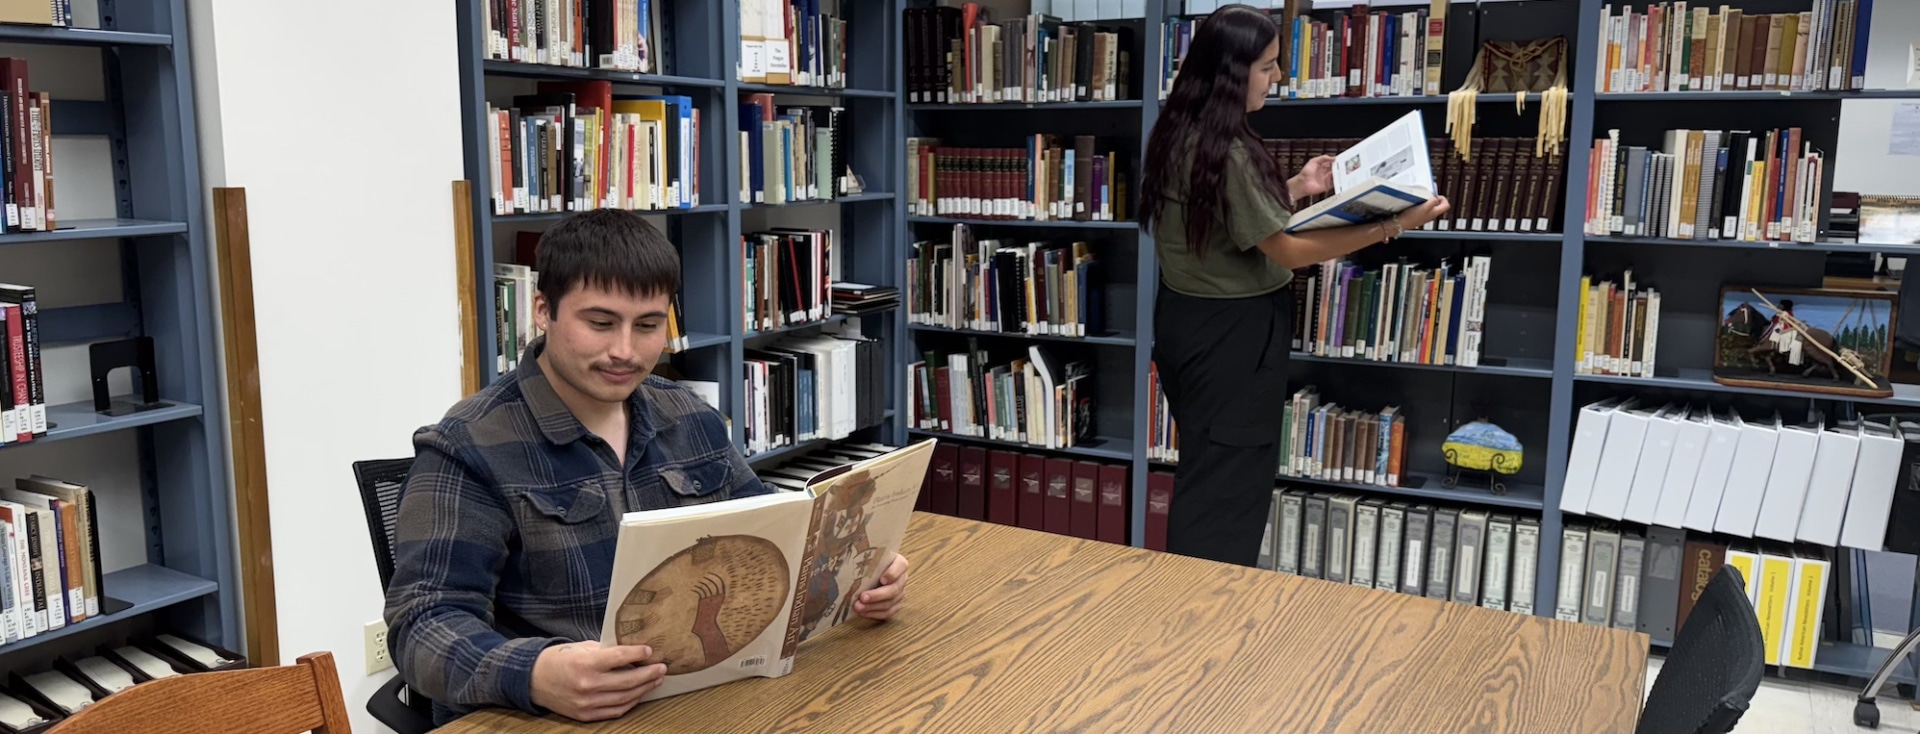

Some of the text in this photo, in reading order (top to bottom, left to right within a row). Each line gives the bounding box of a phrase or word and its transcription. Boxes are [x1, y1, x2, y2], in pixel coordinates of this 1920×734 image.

[32, 111, 40, 122] THE
[12, 335, 24, 371] TRUSTEESHIP
[16, 371, 24, 382] IN
[20, 552, 28, 581] MONTANA
[34, 571, 43, 597] INDIAN
[1805, 580, 1813, 597] Volume
[785, 556, 814, 646] Plains Indian Art
[1766, 595, 1774, 621] Newsletters
[1801, 599, 1811, 624] Newsletters
[1799, 625, 1807, 646] American
[1797, 647, 1805, 661] Native
